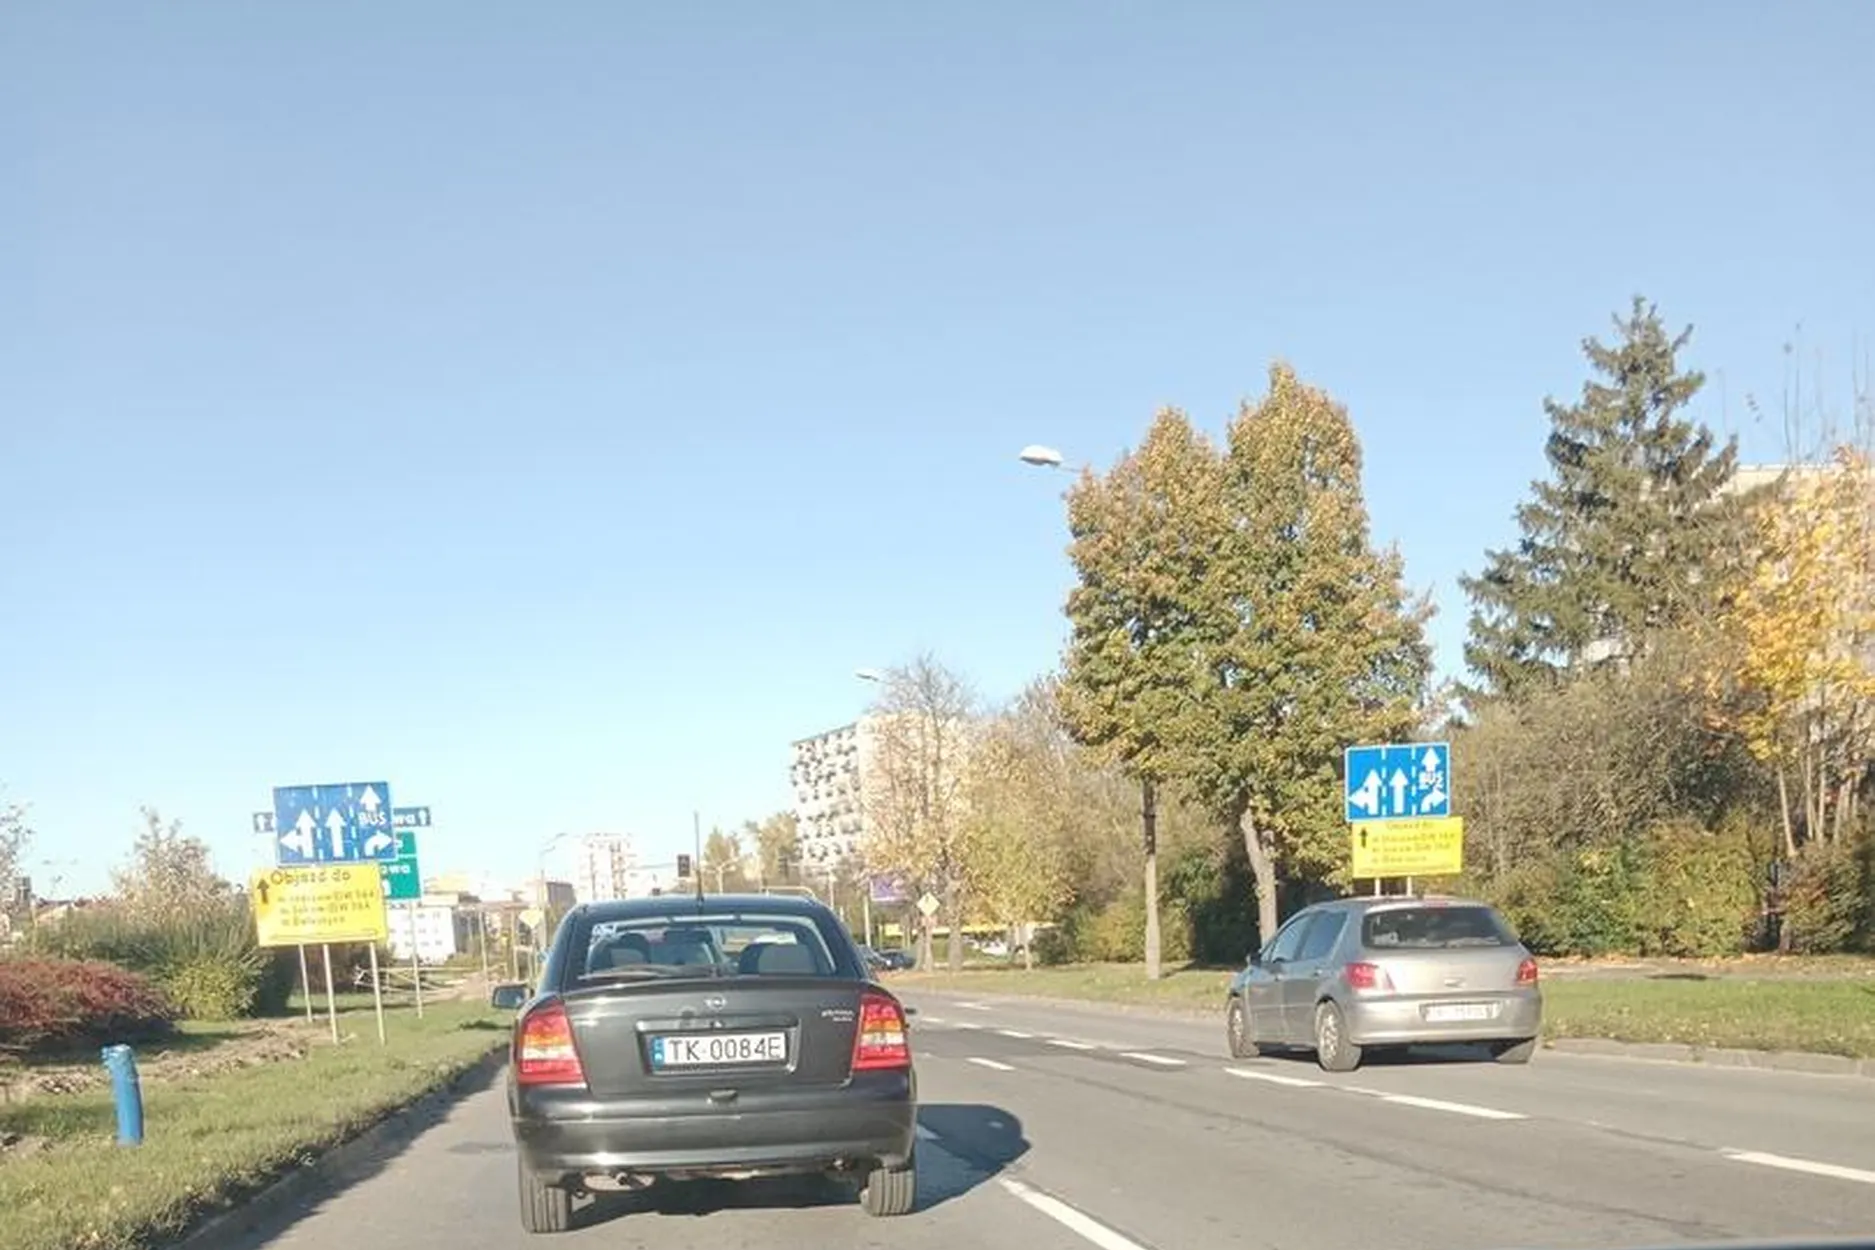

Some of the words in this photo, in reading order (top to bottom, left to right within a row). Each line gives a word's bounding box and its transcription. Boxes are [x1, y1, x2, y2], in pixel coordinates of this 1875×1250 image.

[358, 811, 387, 826] BUS
[331, 868, 352, 882] do
[669, 1039, 700, 1061] TK
[710, 1036, 782, 1060] 0084E
